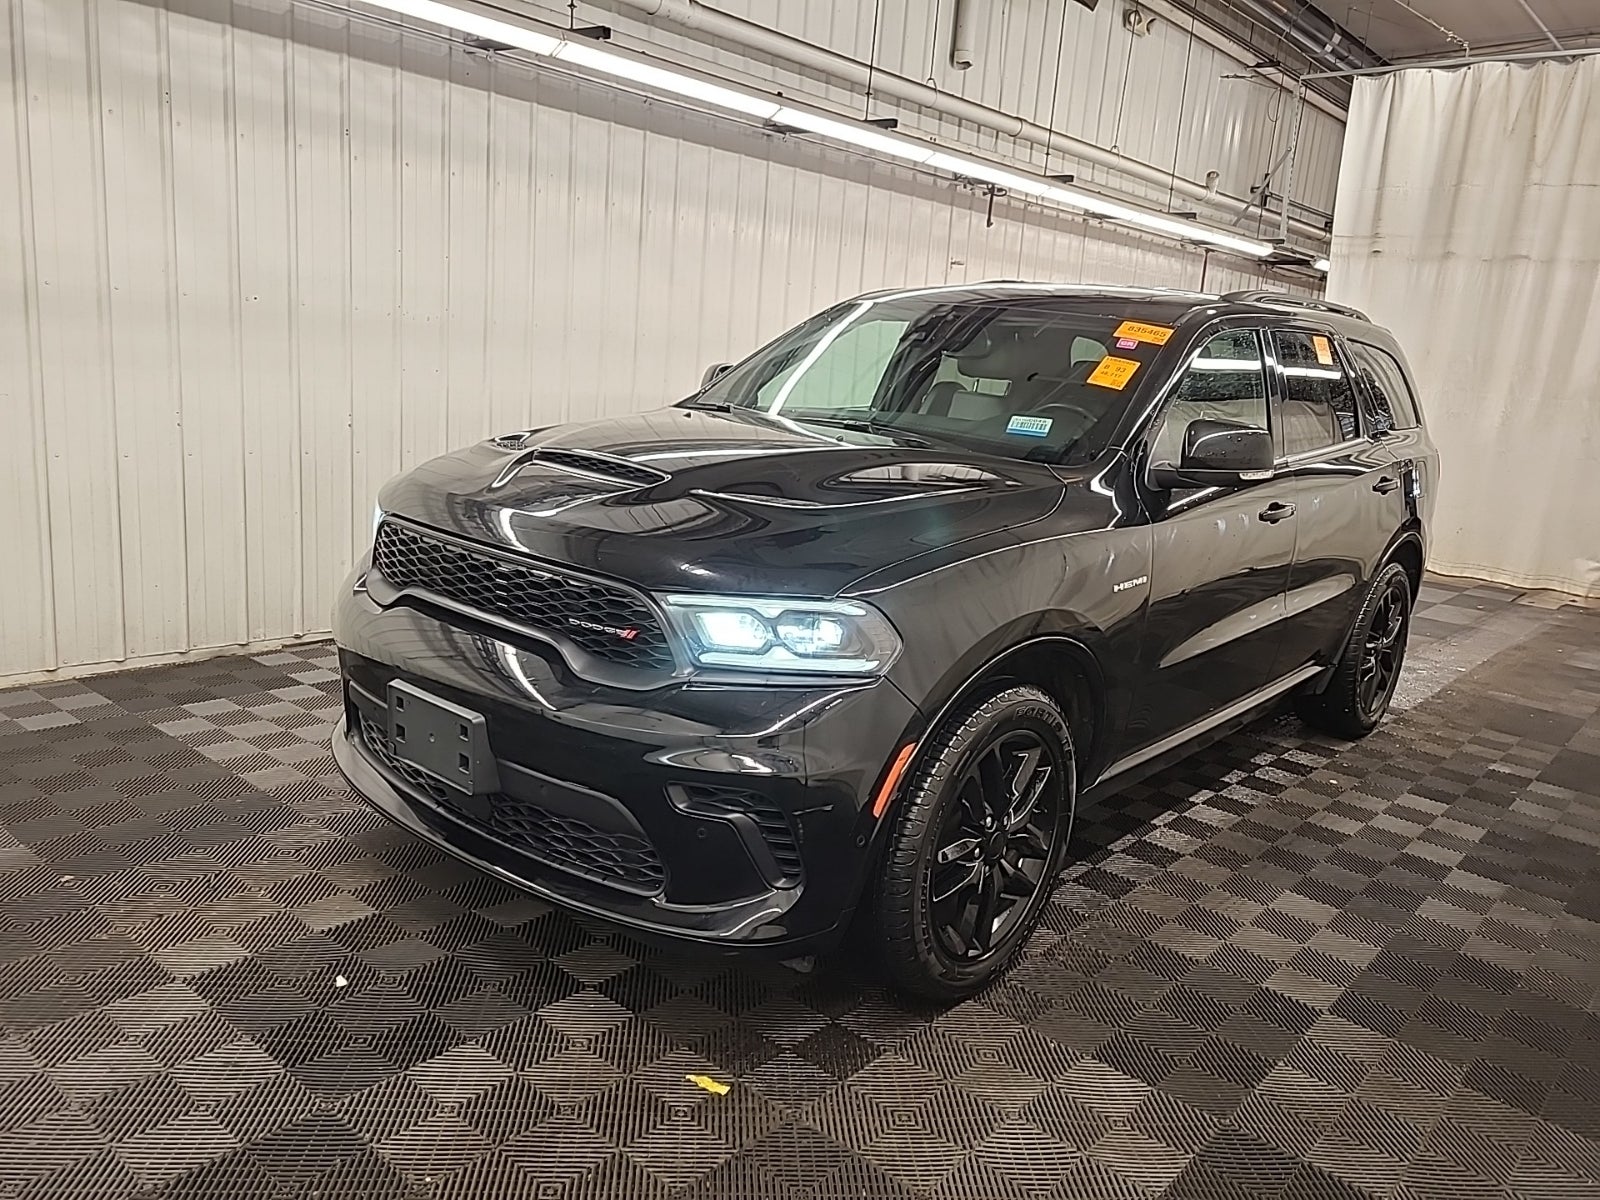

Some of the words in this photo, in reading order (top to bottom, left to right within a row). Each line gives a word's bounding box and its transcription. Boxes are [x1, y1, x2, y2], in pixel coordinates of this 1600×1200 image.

[1127, 325, 1167, 337] 835465
[1113, 575, 1148, 593] HEMI
[568, 618, 625, 638] DODGE
